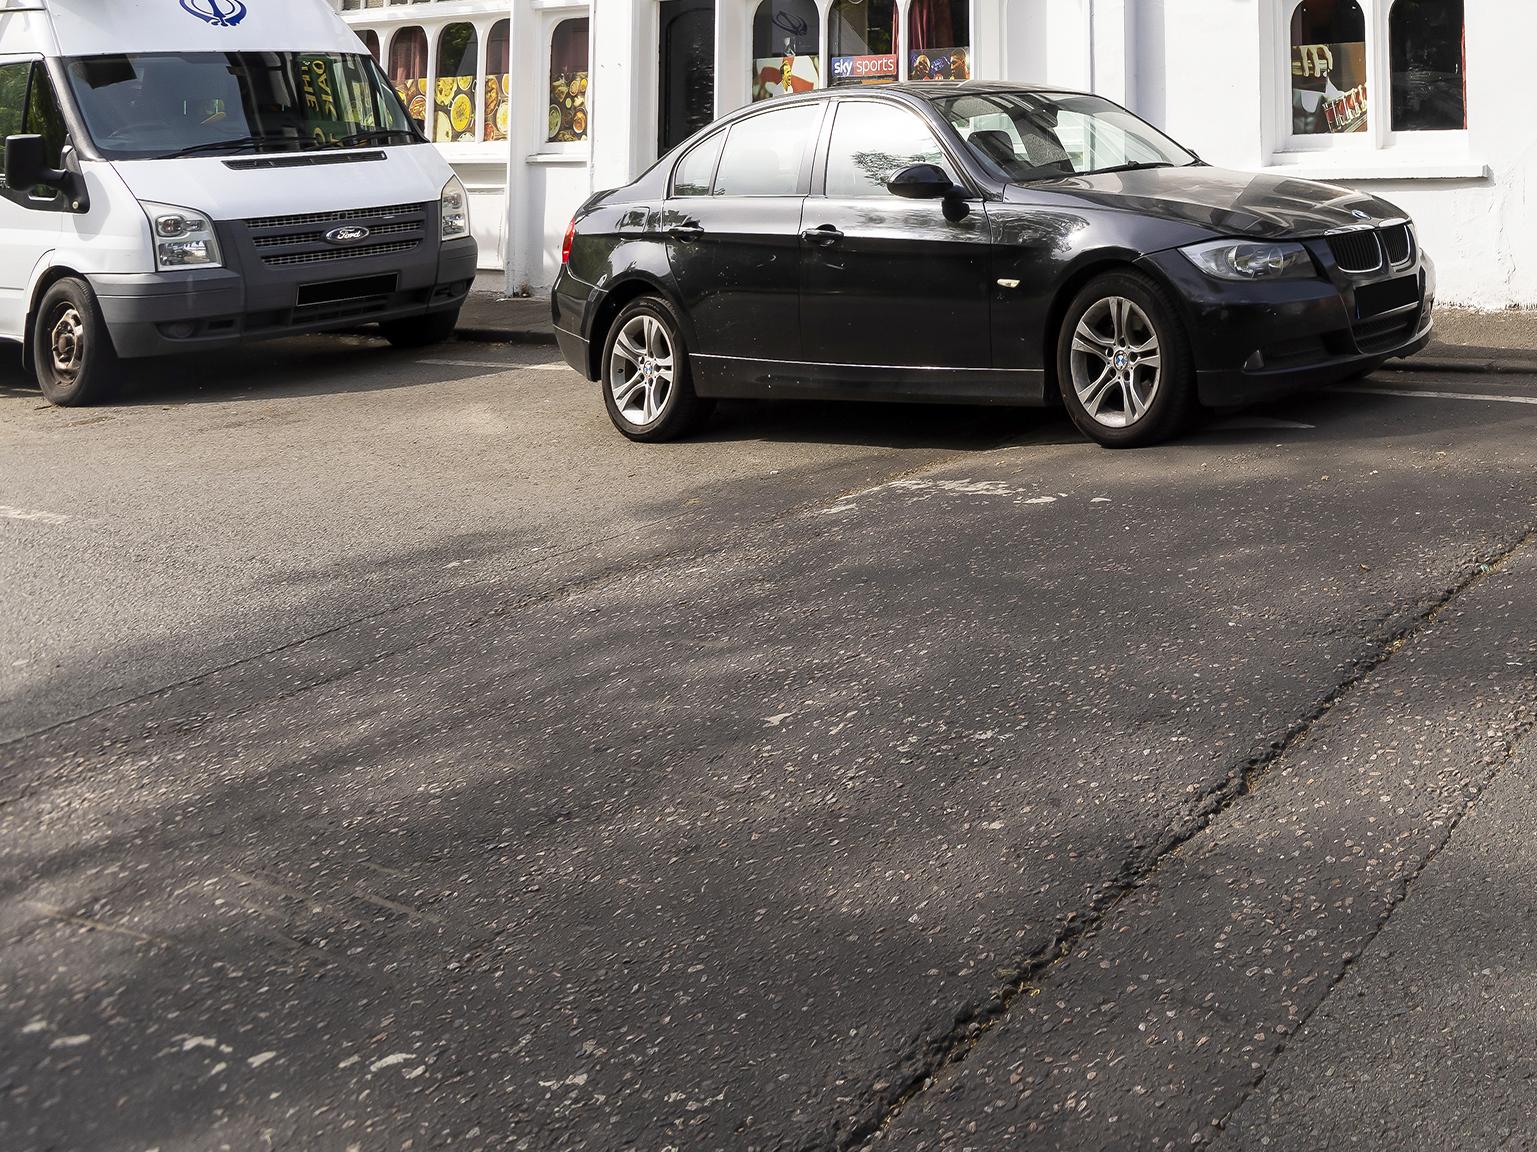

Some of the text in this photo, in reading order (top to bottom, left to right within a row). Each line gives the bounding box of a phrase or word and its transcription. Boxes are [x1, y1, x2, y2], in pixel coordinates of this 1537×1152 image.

[834, 58, 895, 77] sky sports
[337, 229, 361, 239] Ford
